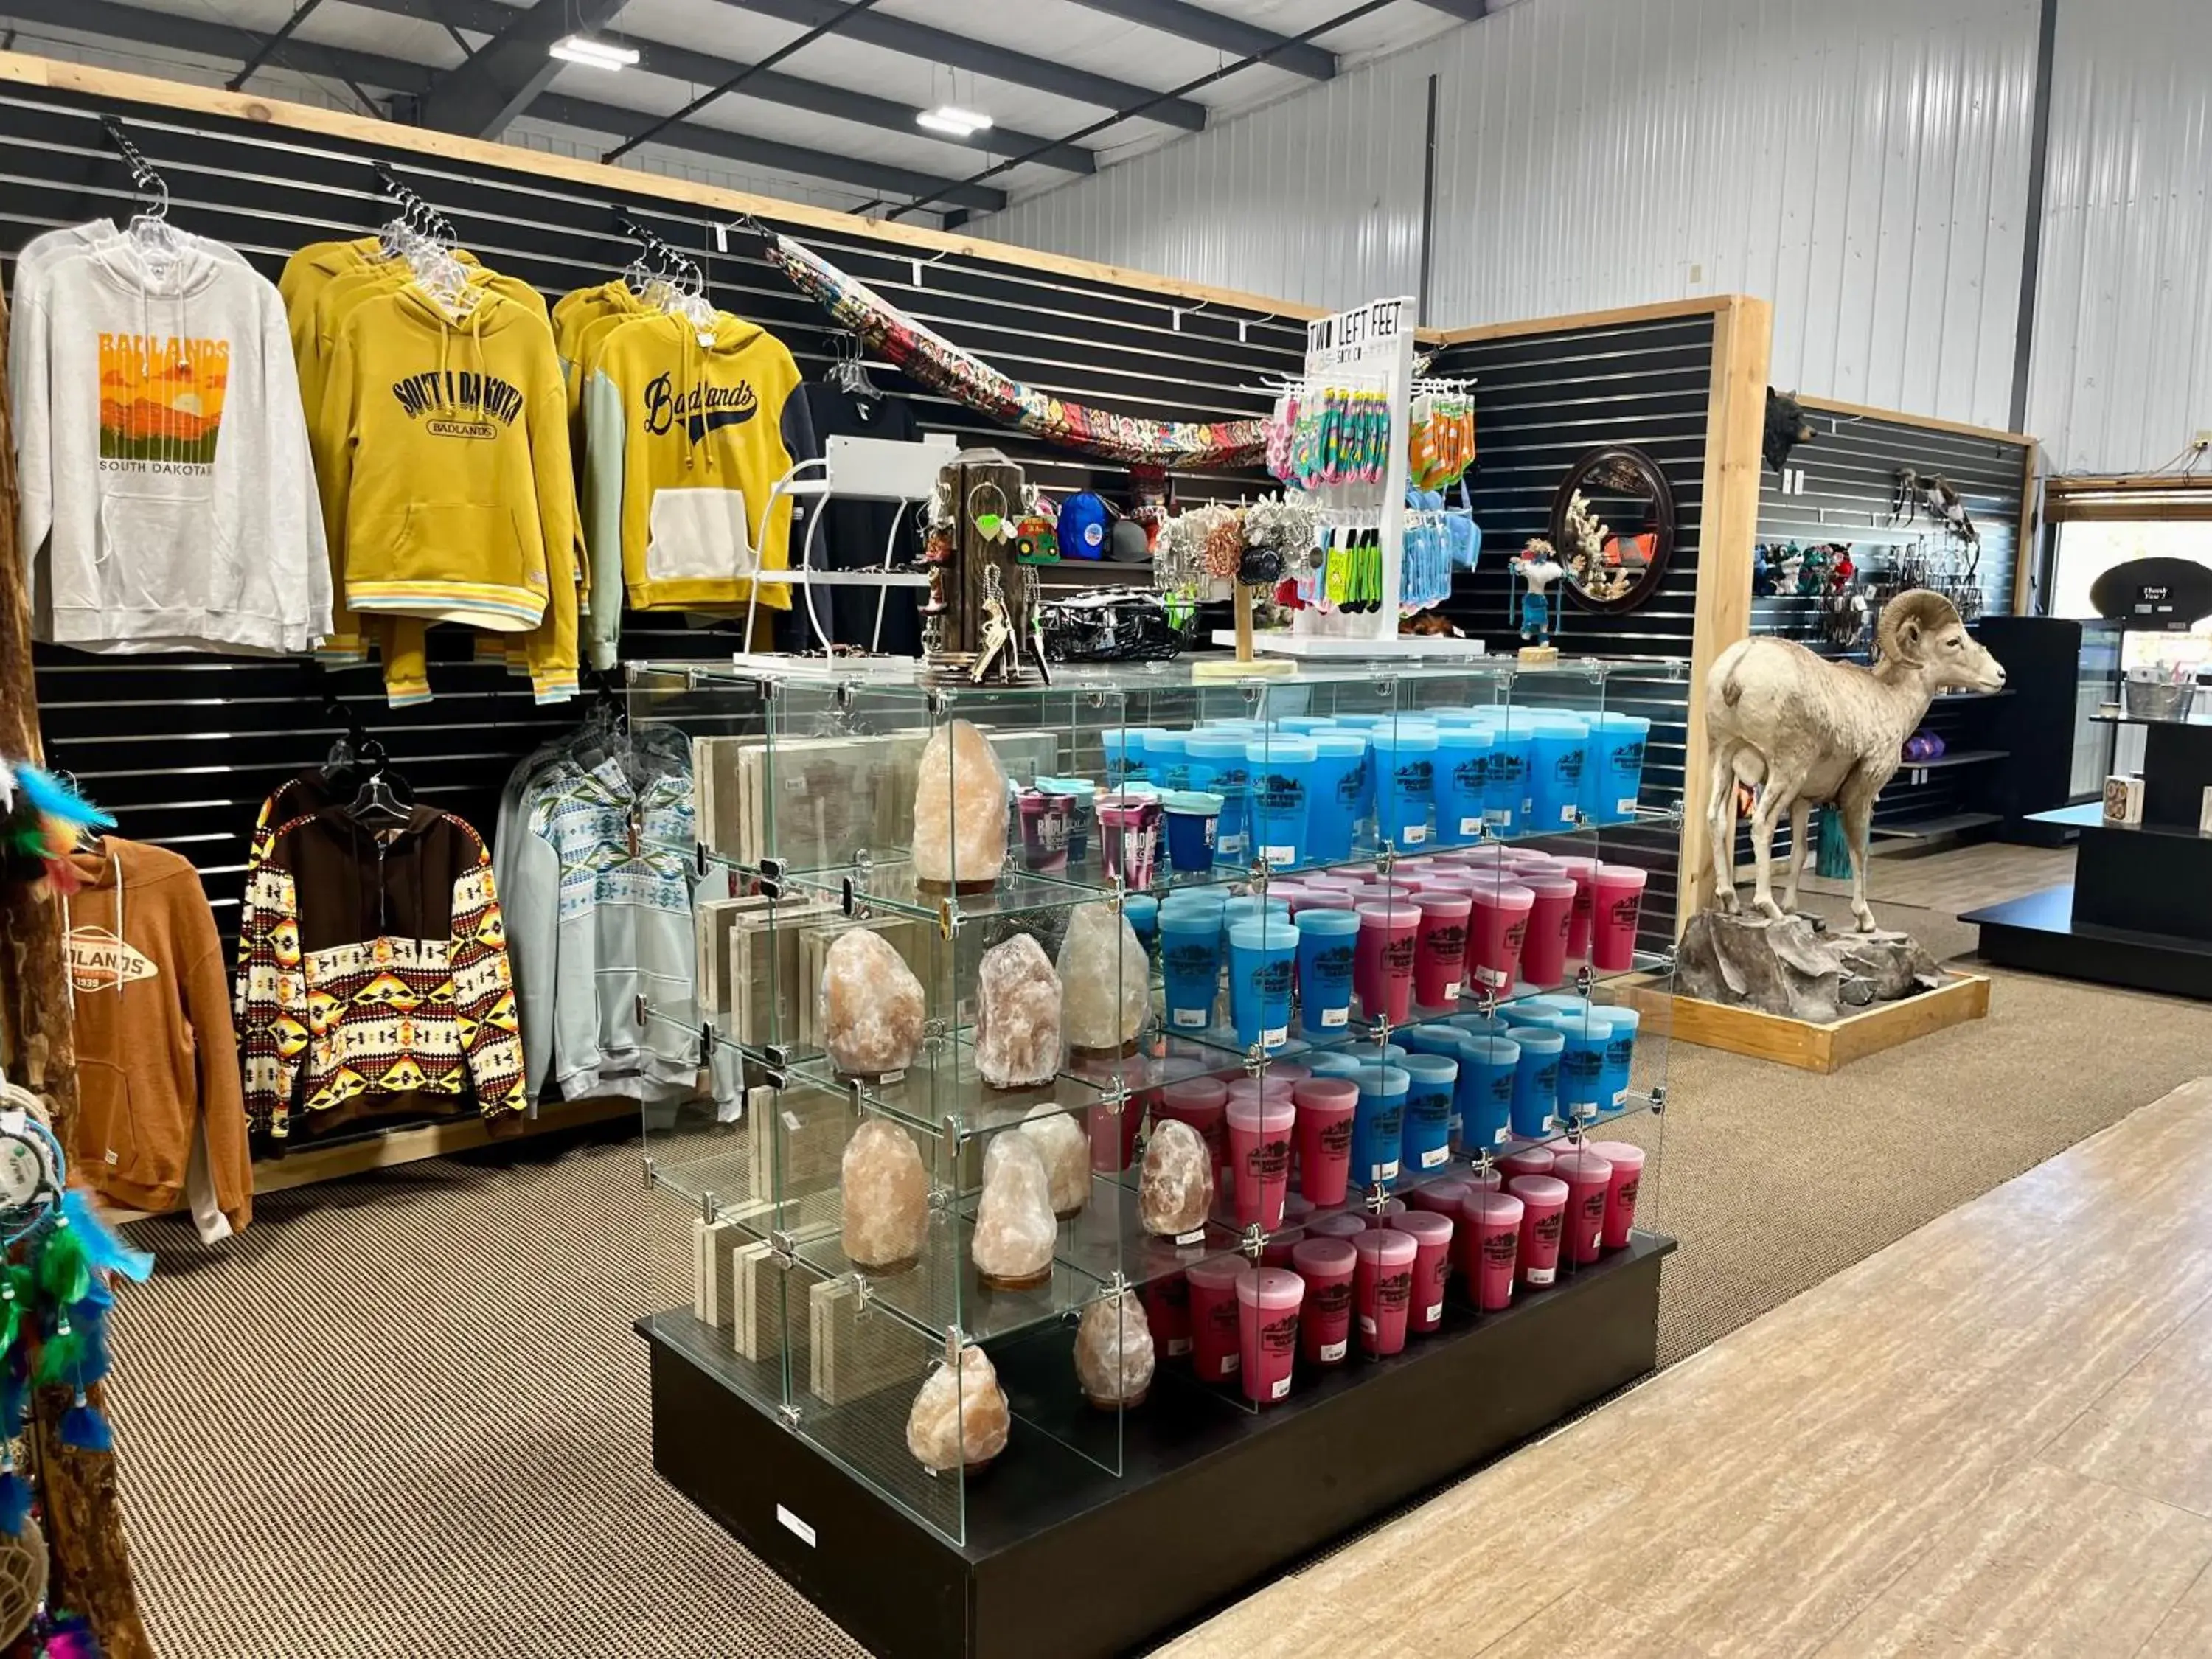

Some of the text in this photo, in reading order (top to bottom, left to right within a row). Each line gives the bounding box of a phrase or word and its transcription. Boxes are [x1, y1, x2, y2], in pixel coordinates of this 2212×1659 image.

[1310, 301, 1401, 353] TWO LEFT FEET
[100, 333, 229, 358] BADLANDS
[459, 371, 523, 428] DAKOTA
[433, 422, 492, 437] BADLANDS
[100, 461, 213, 476] SOUTH DAKOTA
